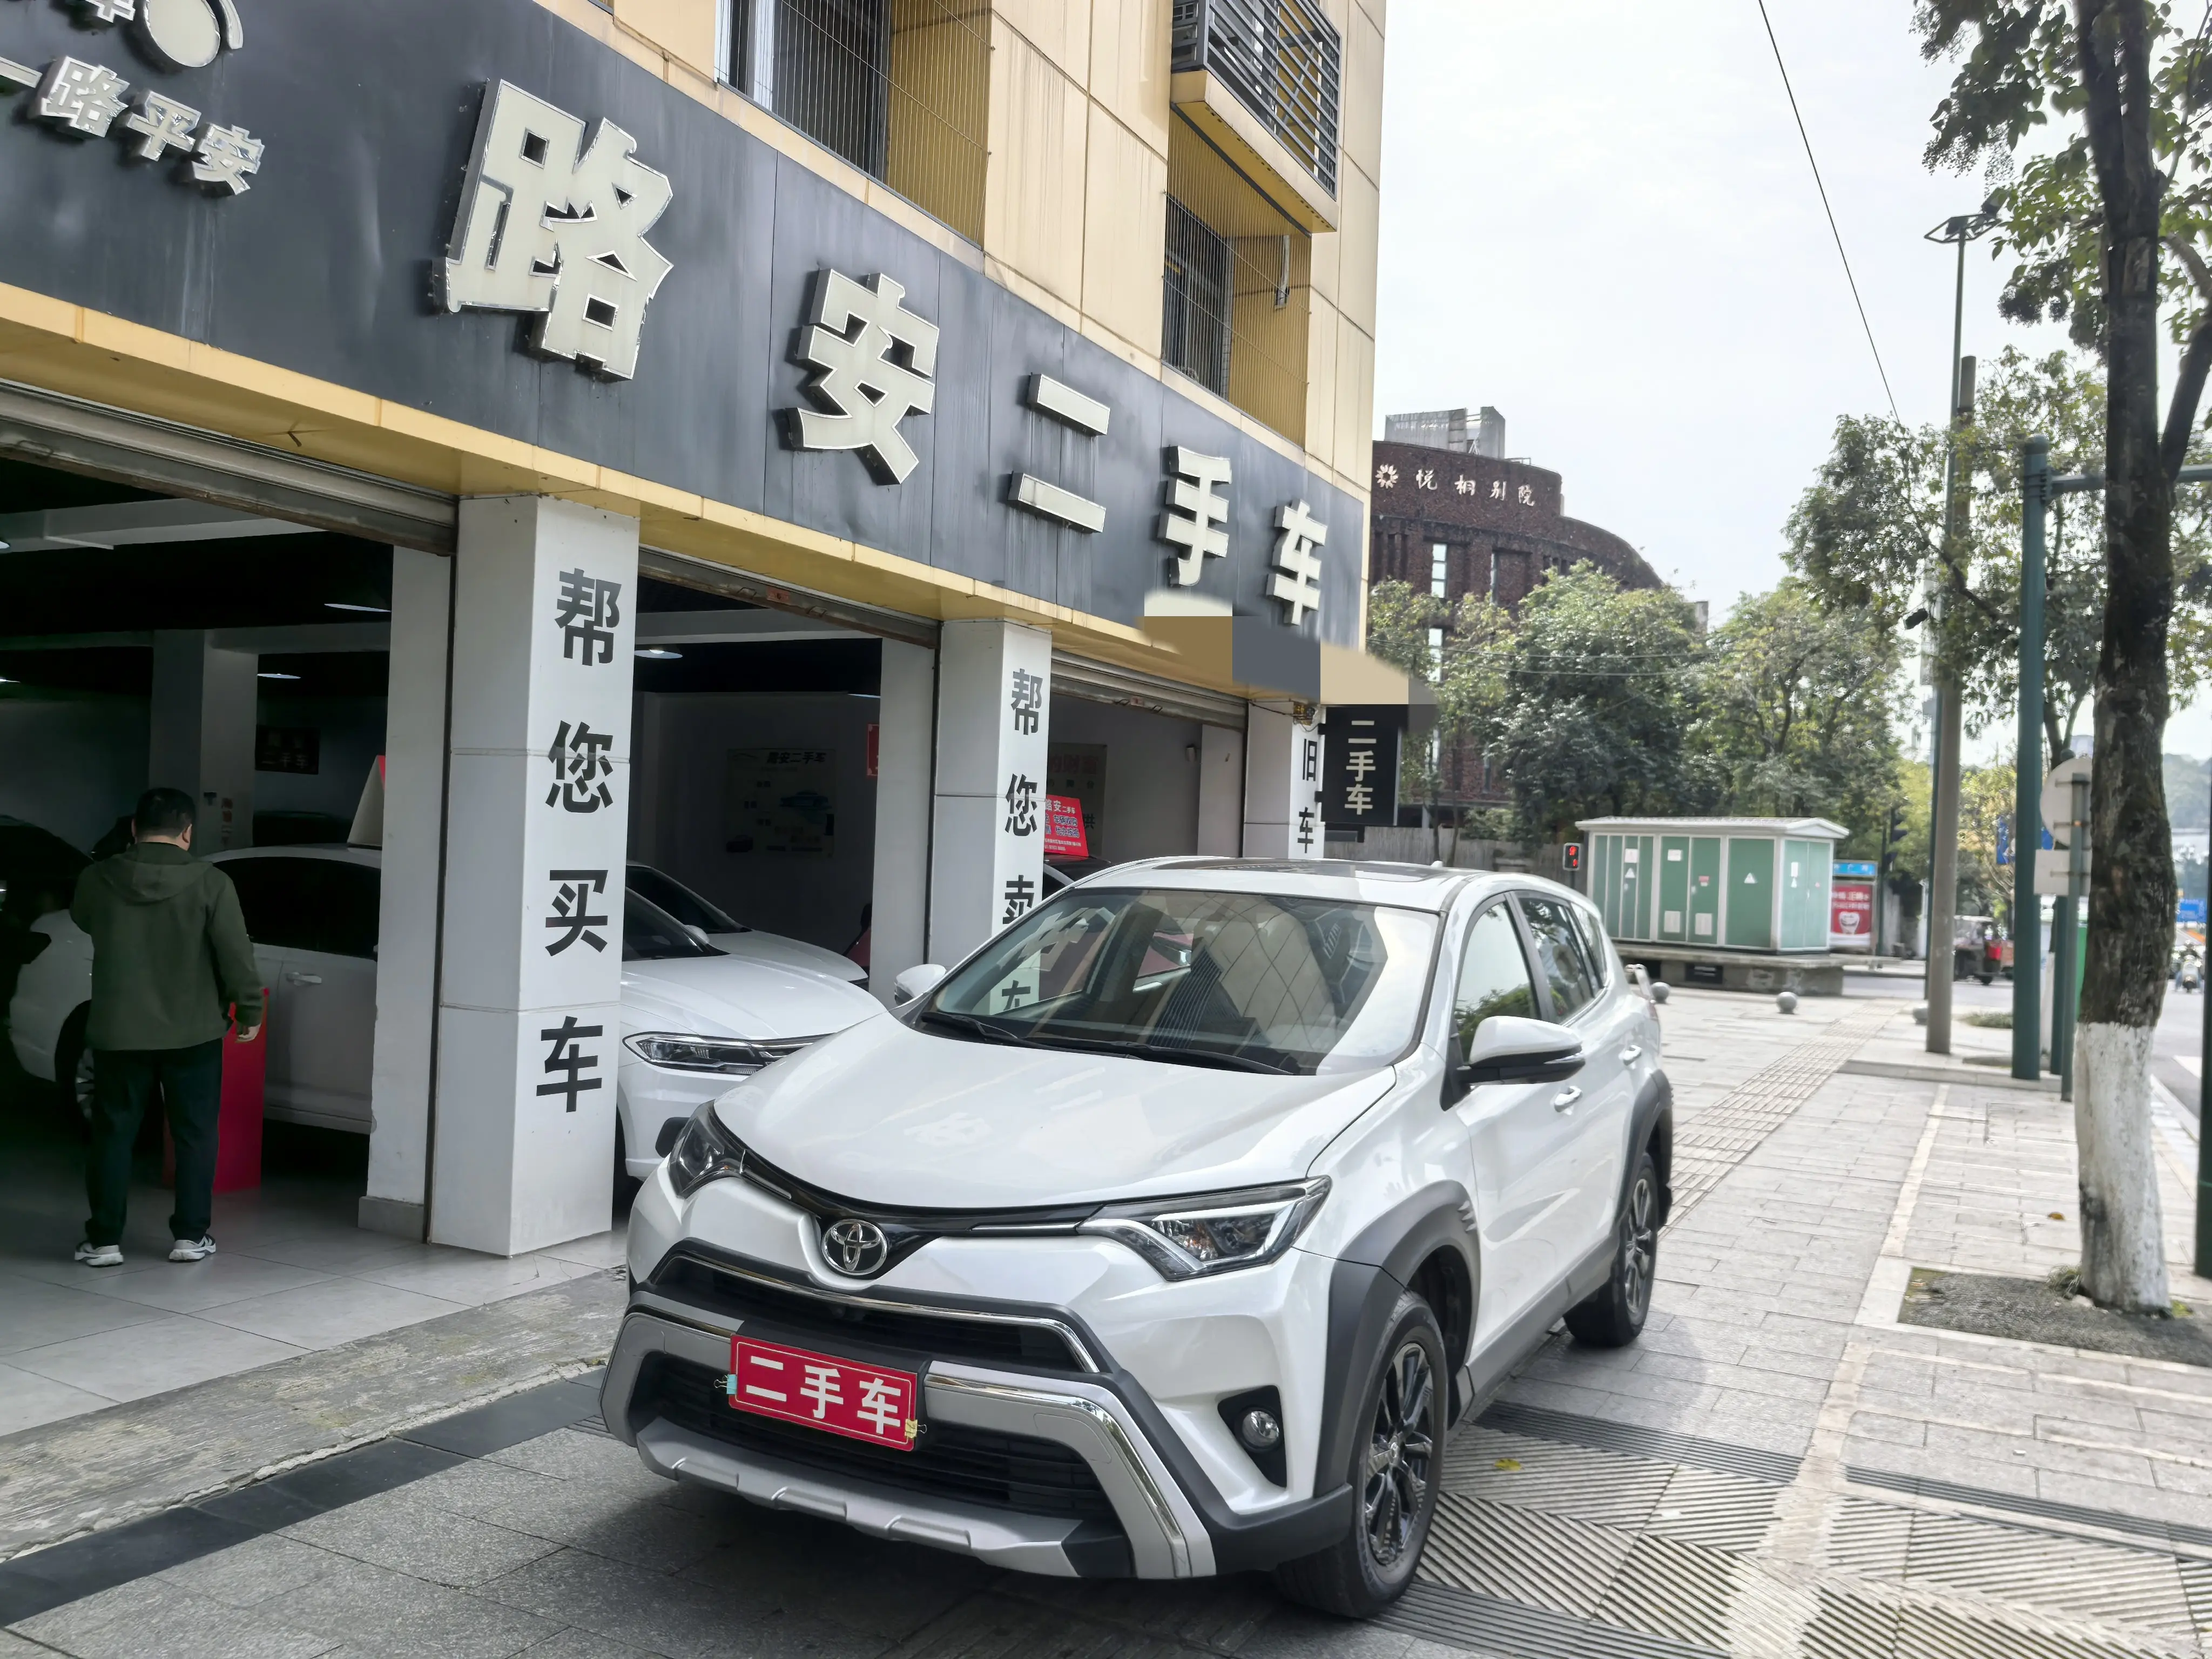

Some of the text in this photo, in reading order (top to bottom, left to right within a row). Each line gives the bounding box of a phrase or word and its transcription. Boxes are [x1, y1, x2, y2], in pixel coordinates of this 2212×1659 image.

[446, 79, 1328, 626] 路安二手车
[1415, 468, 1535, 507] 悦桐别院
[1345, 720, 1377, 815] 二手车
[536, 568, 622, 1112] 帮您买车
[746, 1355, 901, 1434] 二手车
